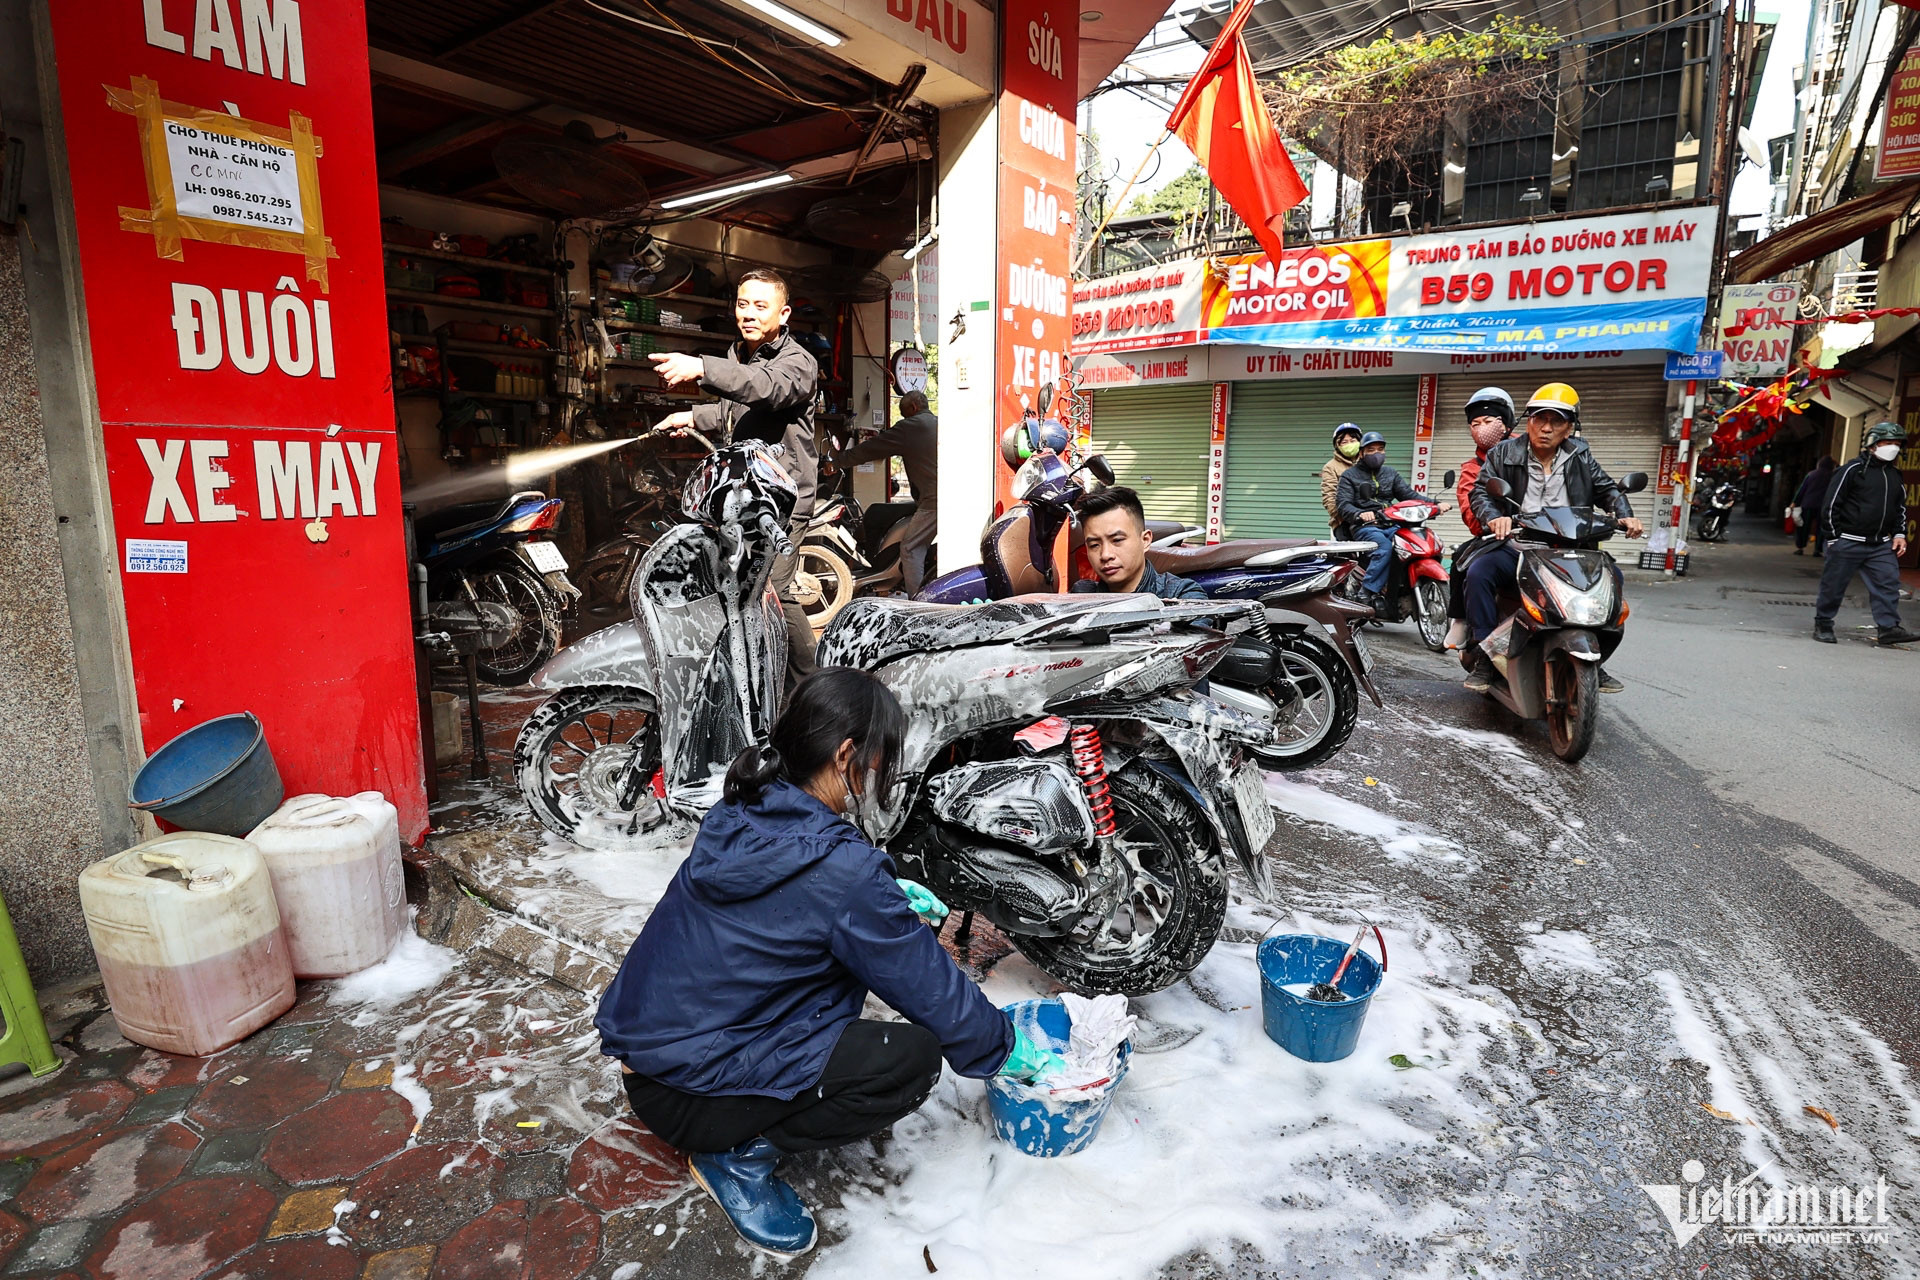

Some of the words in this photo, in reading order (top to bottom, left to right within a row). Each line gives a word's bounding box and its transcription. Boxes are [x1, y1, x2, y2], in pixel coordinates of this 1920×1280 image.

[1028, 12, 1063, 80] SỬA
[168, 124, 198, 139] CHO
[1019, 99, 1066, 161] CHỮA
[188, 146, 219, 160] NHÀ
[232, 154, 258, 168] CĂN
[262, 160, 281, 174] HỘ
[185, 182, 206, 195] LH:
[210, 186, 292, 209] 0986.207.295
[1024, 177, 1058, 237] BẢO
[213, 205, 293, 226] 0987.545.237
[1407, 244, 1461, 265] TRUNG
[1467, 239, 1502, 260] TÂM
[1508, 232, 1545, 256] BẢO
[1552, 230, 1616, 252] DƯỠNG
[1622, 227, 1648, 246] XE
[1654, 219, 1697, 243] MÁY
[1228, 253, 1351, 292] ENEOS
[1420, 272, 1494, 306] B59
[1508, 258, 1668, 299] MOTOR
[1009, 257, 1067, 317] DƯỠNG
[1772, 290, 1792, 301] 61
[1227, 292, 1306, 315] MOTOR
[1312, 289, 1348, 309] OIL
[171, 276, 336, 379] ĐUÔI
[1072, 310, 1102, 336] B59
[1107, 299, 1175, 331] MOTOR
[1406, 317, 1460, 330] Khách
[1465, 317, 1518, 328] Hàng
[1496, 325, 1545, 342] MÁ
[1555, 320, 1670, 339] PHANH
[1246, 356, 1265, 373] UY
[1269, 350, 1292, 372] TÍN
[1303, 349, 1341, 370] CHẤT
[1344, 351, 1393, 373] LƯỢNG
[1702, 355, 1713, 367] 61
[1722, 339, 1789, 362] NGAN
[1012, 345, 1035, 388] XE
[1038, 349, 1061, 391] GA
[1108, 362, 1135, 384] NGHIỆP
[1142, 359, 1164, 380] LÀNH
[1166, 355, 1188, 377] NGHỀ
[1214, 386, 1222, 413] ENEOS
[1421, 376, 1429, 406] ENEOS
[136, 438, 237, 524] XE
[253, 423, 382, 520] MÁY
[131, 563, 185, 572] 0912.560.925
[1043, 657, 1084, 672] mode
